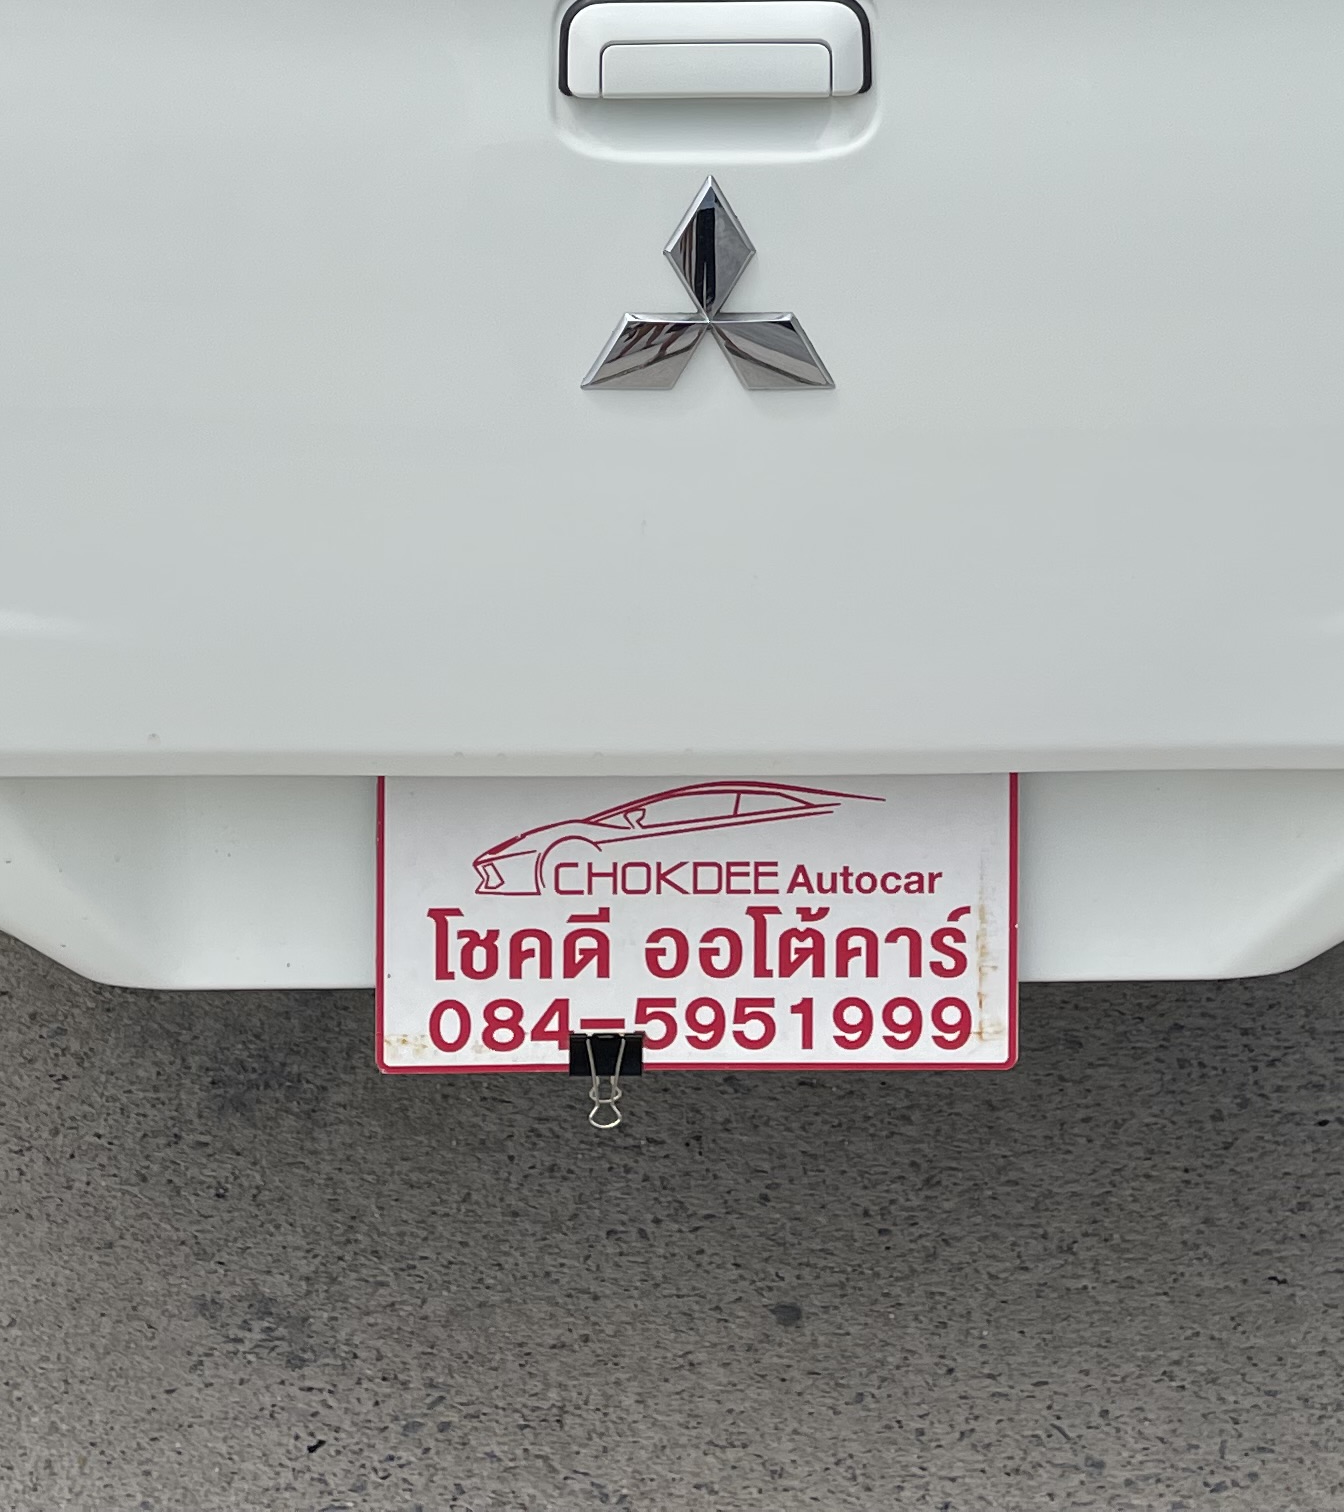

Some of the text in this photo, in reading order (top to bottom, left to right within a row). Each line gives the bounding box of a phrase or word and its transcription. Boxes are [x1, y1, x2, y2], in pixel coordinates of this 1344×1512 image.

[554, 861, 943, 896] CHOKDEE Autocar
[427, 905, 972, 981] โชคดี ออโต้คาร์
[428, 996, 973, 1053] 084-5951999
